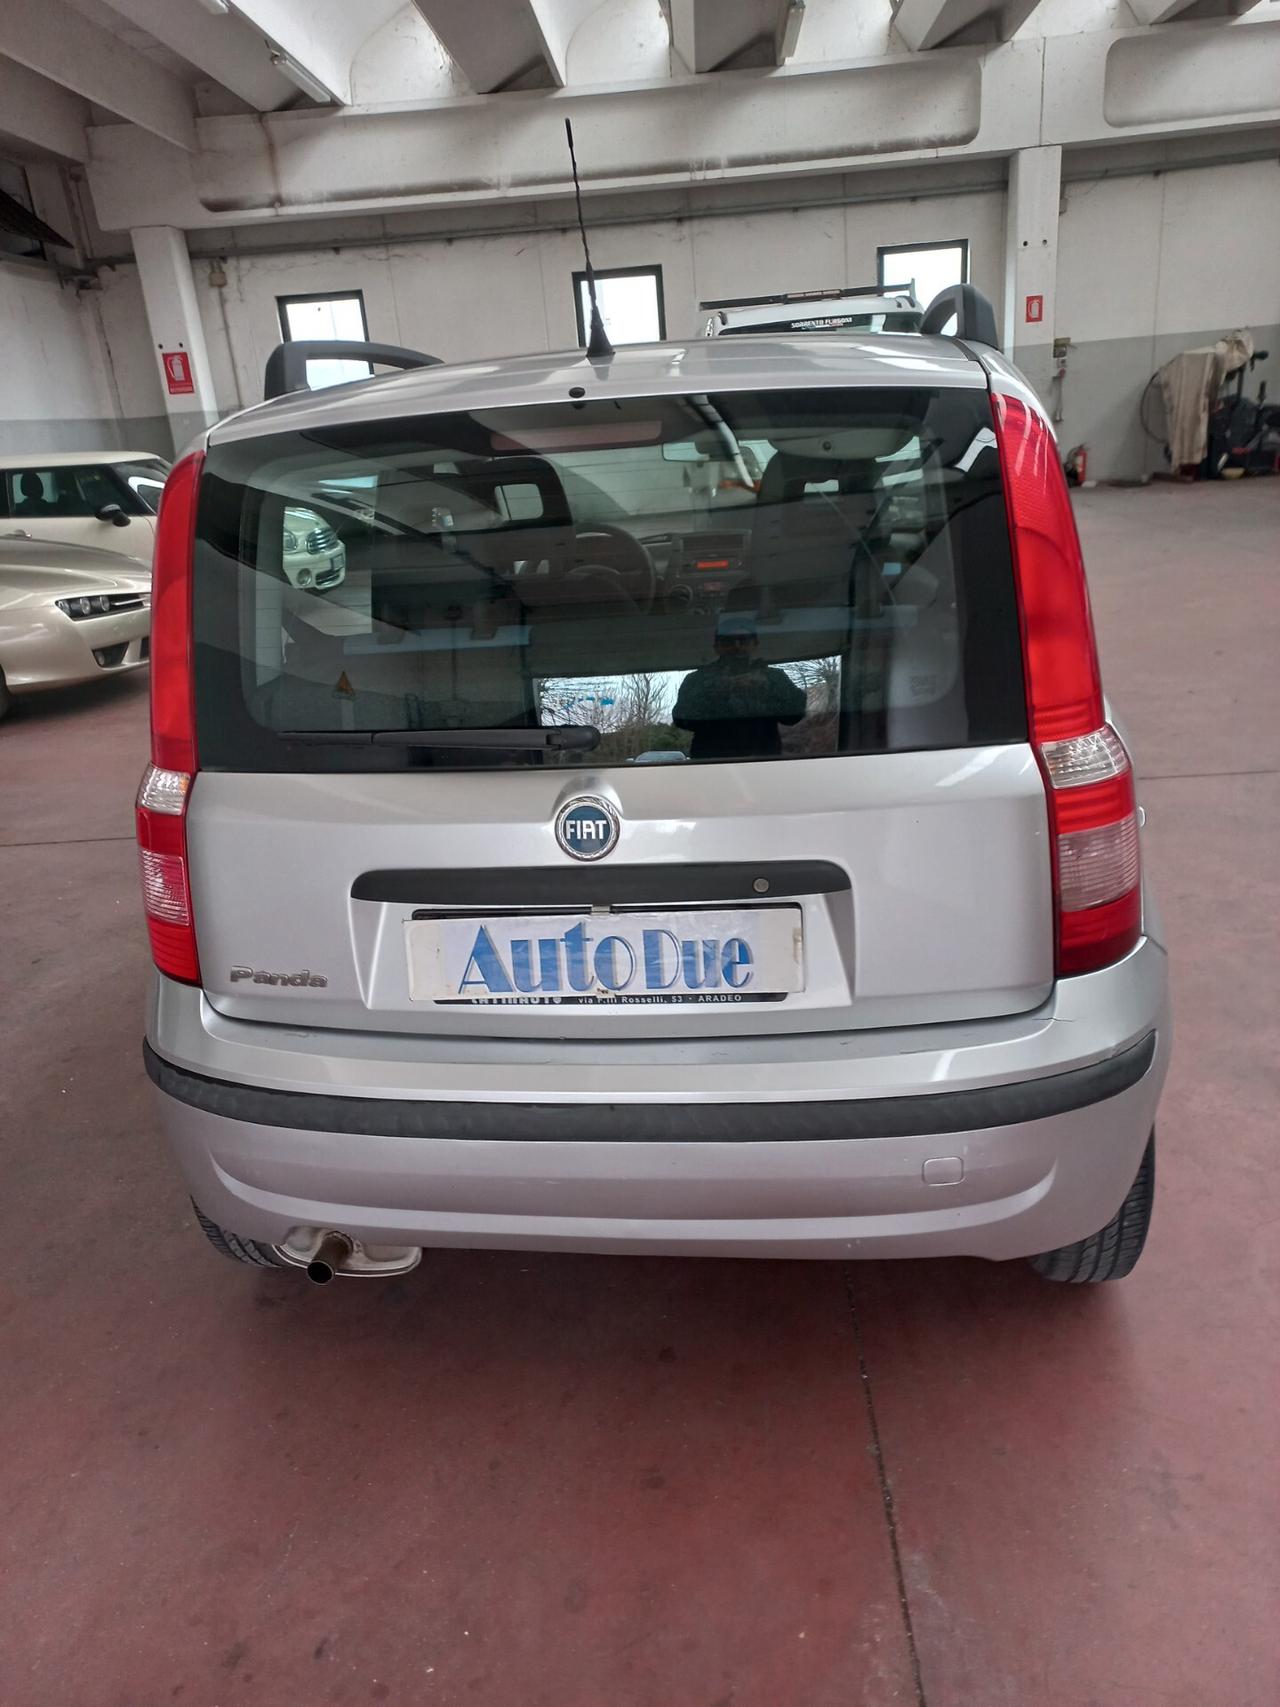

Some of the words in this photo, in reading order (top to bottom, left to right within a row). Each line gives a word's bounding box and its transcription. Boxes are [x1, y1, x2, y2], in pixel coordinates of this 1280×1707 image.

[565, 819, 608, 840] FIAT
[229, 965, 328, 988] Panda
[698, 994, 742, 1002] ARADEO
